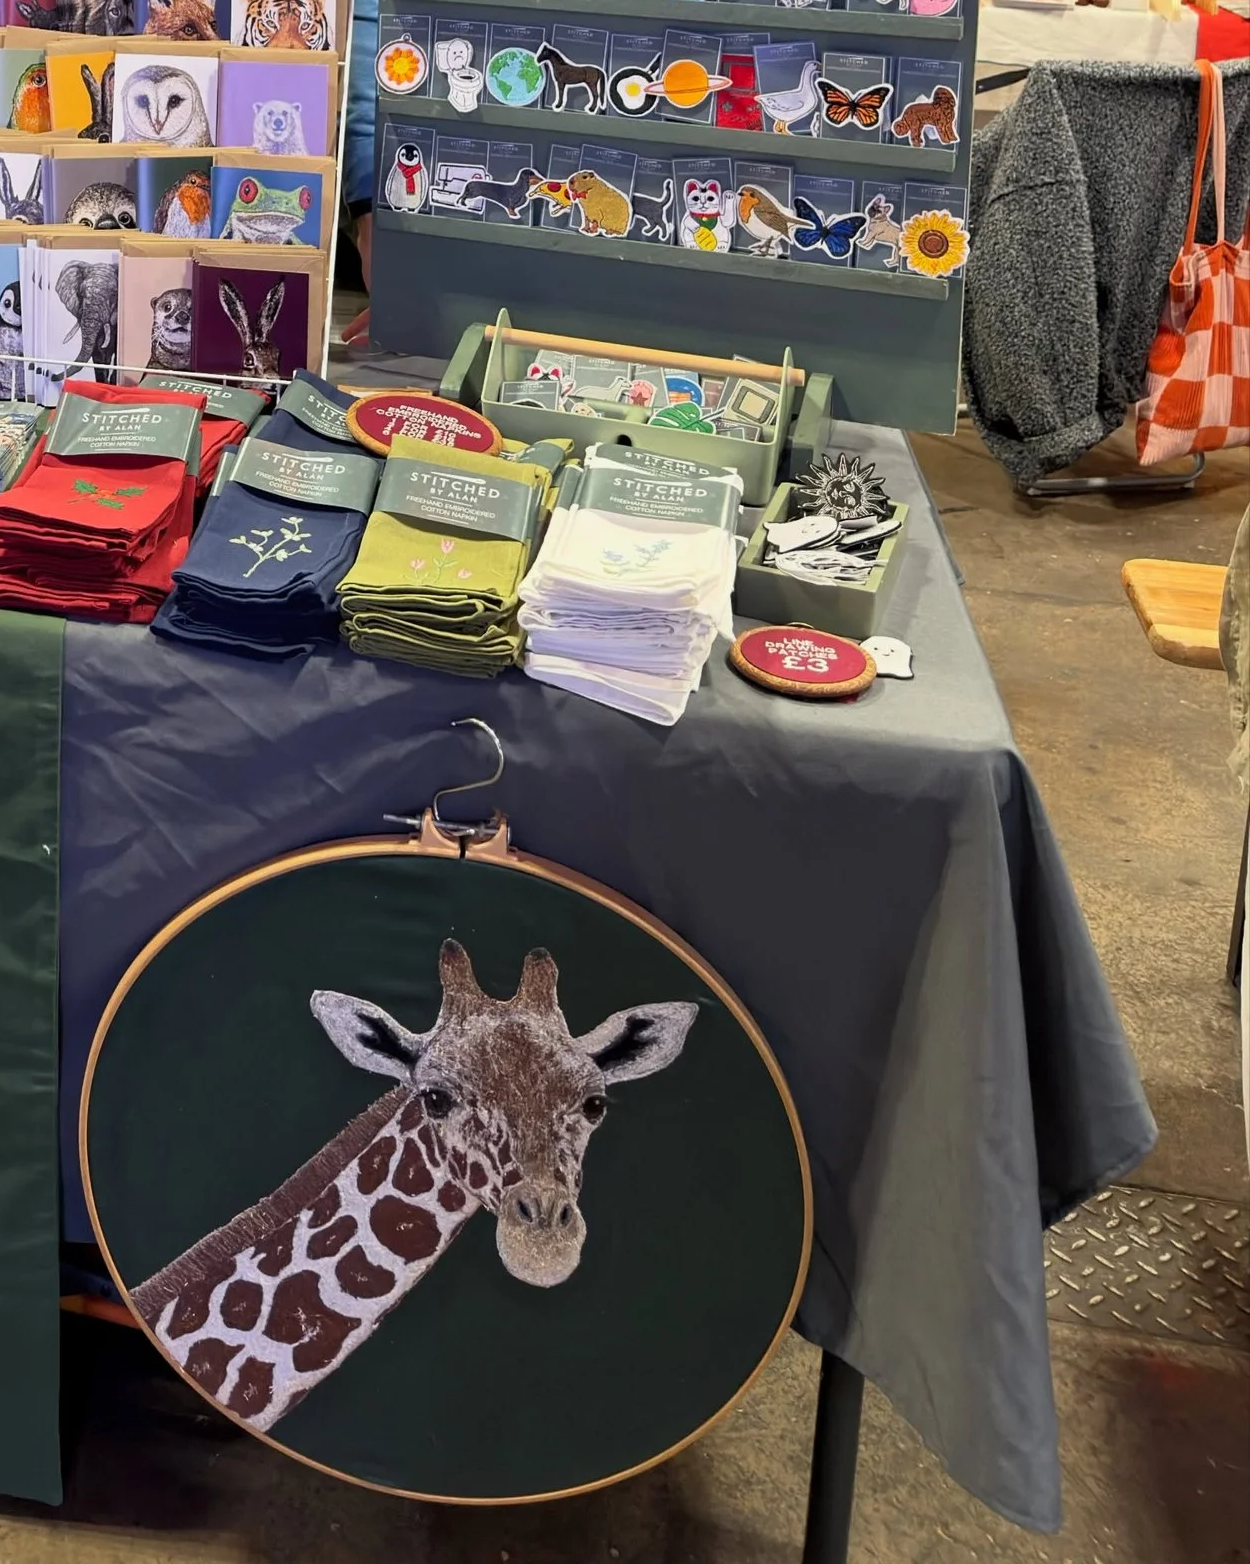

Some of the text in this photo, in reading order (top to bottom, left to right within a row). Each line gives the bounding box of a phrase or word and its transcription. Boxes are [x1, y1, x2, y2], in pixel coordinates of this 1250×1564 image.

[159, 381, 232, 399] STITCHED
[308, 395, 347, 422] STITC
[400, 404, 459, 423] FREEHAND
[81, 412, 162, 424] STITCHED
[376, 409, 482, 438] COTTON NAPKINS
[388, 406, 467, 431] EMBROIDERED
[403, 421, 428, 431] FOR
[262, 452, 346, 474] STITCHED
[624, 451, 710, 475] STITCHED
[256, 471, 339, 493] FREEHAND EMBROIDERED
[295, 469, 324, 480] ALAN
[268, 481, 323, 497] COTTON NAPKIN
[410, 472, 500, 498] STITCHED
[613, 478, 708, 497] STITCHED
[446, 492, 478, 503] ALAN
[610, 496, 704, 513] FREEHAND EMBROIDERED
[653, 494, 684, 502] ALAN
[406, 495, 495, 519] FREEHAND EMBROIDERED
[421, 505, 477, 522] COTTON NAPKIN
[625, 505, 684, 516] COTTON NAPKIN
[765, 641, 836, 654] DRAWING
[783, 637, 814, 647] LINE
[768, 647, 838, 660] PATCHES
[782, 655, 830, 673] £3
